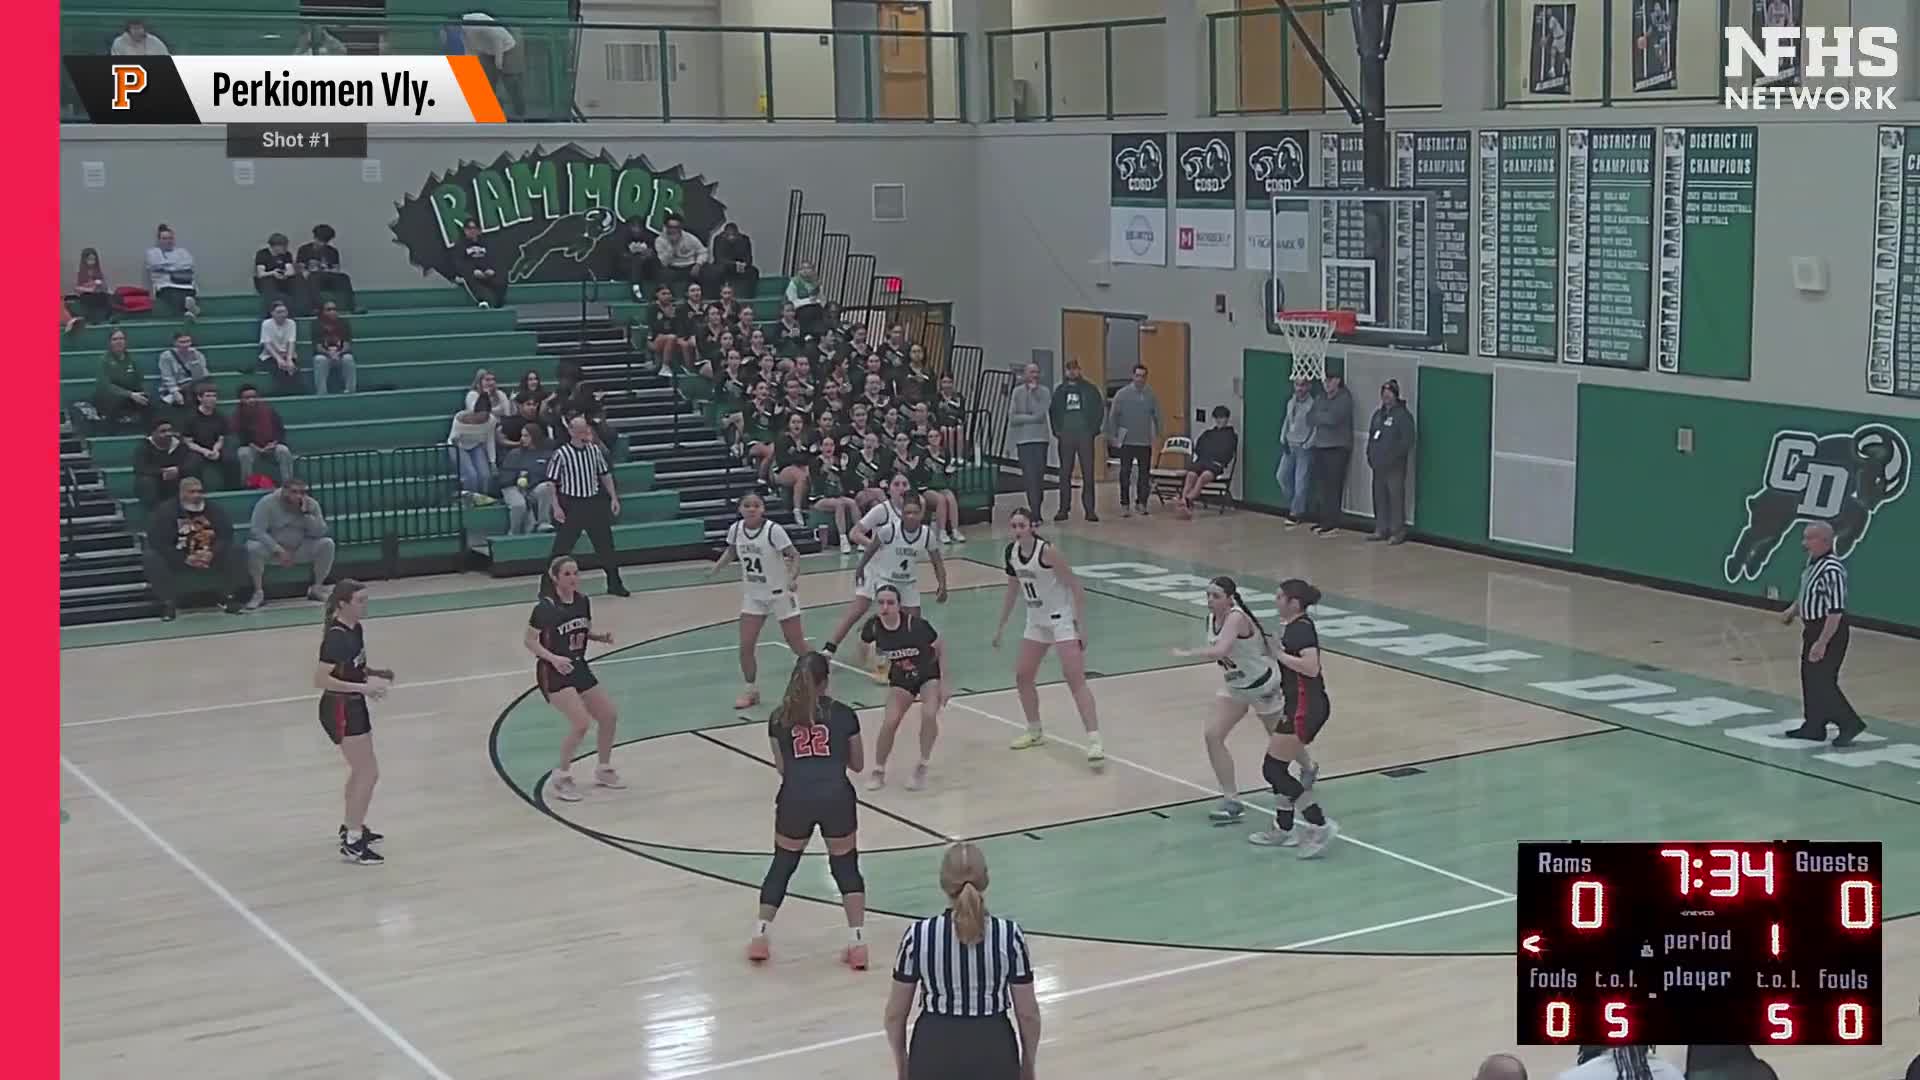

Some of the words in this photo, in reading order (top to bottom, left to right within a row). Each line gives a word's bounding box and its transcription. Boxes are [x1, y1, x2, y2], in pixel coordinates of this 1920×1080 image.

[1417, 137, 1455, 151] DISTRICT
[1502, 135, 1542, 150] DISTRICT
[1592, 134, 1637, 149] DISTRICT
[1639, 134, 1651, 148] III
[1689, 133, 1737, 149] DISTRICT
[1740, 133, 1752, 148] III
[1418, 159, 1465, 173] CHAMPIONS
[1502, 159, 1555, 173] CHAMPIONS
[1592, 159, 1650, 173] CHAMPIONS
[1689, 158, 1751, 174] CHAMPIONS
[430, 160, 562, 248] RAM
[566, 160, 688, 236] MOB
[1569, 156, 1586, 254] DAUPHIN
[1663, 156, 1683, 258] DAUPHIN
[1876, 157, 1900, 269] DAUPHIN
[1480, 261, 1496, 354] CENTRAL
[1567, 264, 1583, 360] CENTRAL
[1660, 266, 1680, 370] CENTRAL
[1870, 279, 1895, 390] CENTRAL
[1769, 438, 1849, 518] CD
[743, 557, 763, 574] 24
[899, 559, 909, 571] 4
[1024, 582, 1037, 599] 11
[791, 723, 831, 758] 22
